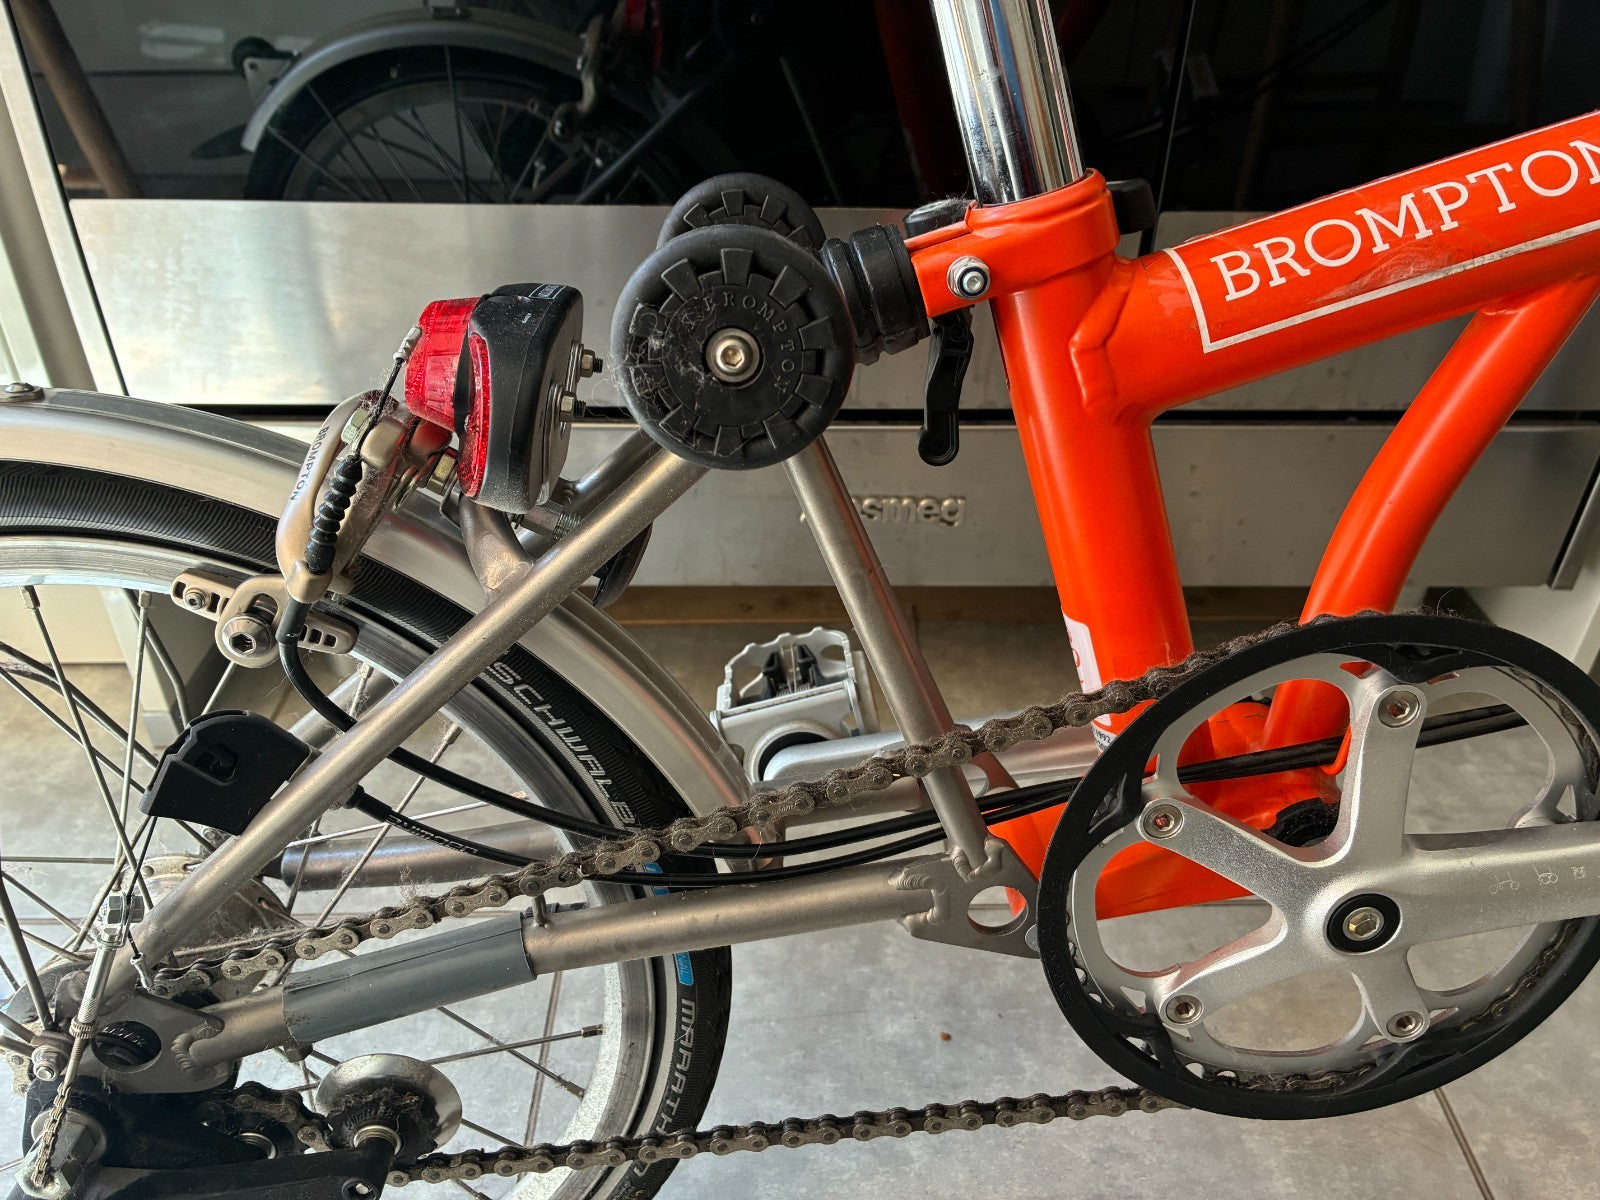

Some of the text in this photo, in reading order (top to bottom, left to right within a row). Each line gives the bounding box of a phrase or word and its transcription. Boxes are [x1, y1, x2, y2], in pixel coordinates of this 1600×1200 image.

[290, 426, 330, 501] BROMPTON
[861, 495, 967, 527] smeg
[487, 661, 641, 832] SCHWALB
[634, 998, 696, 1178] MARATHN
